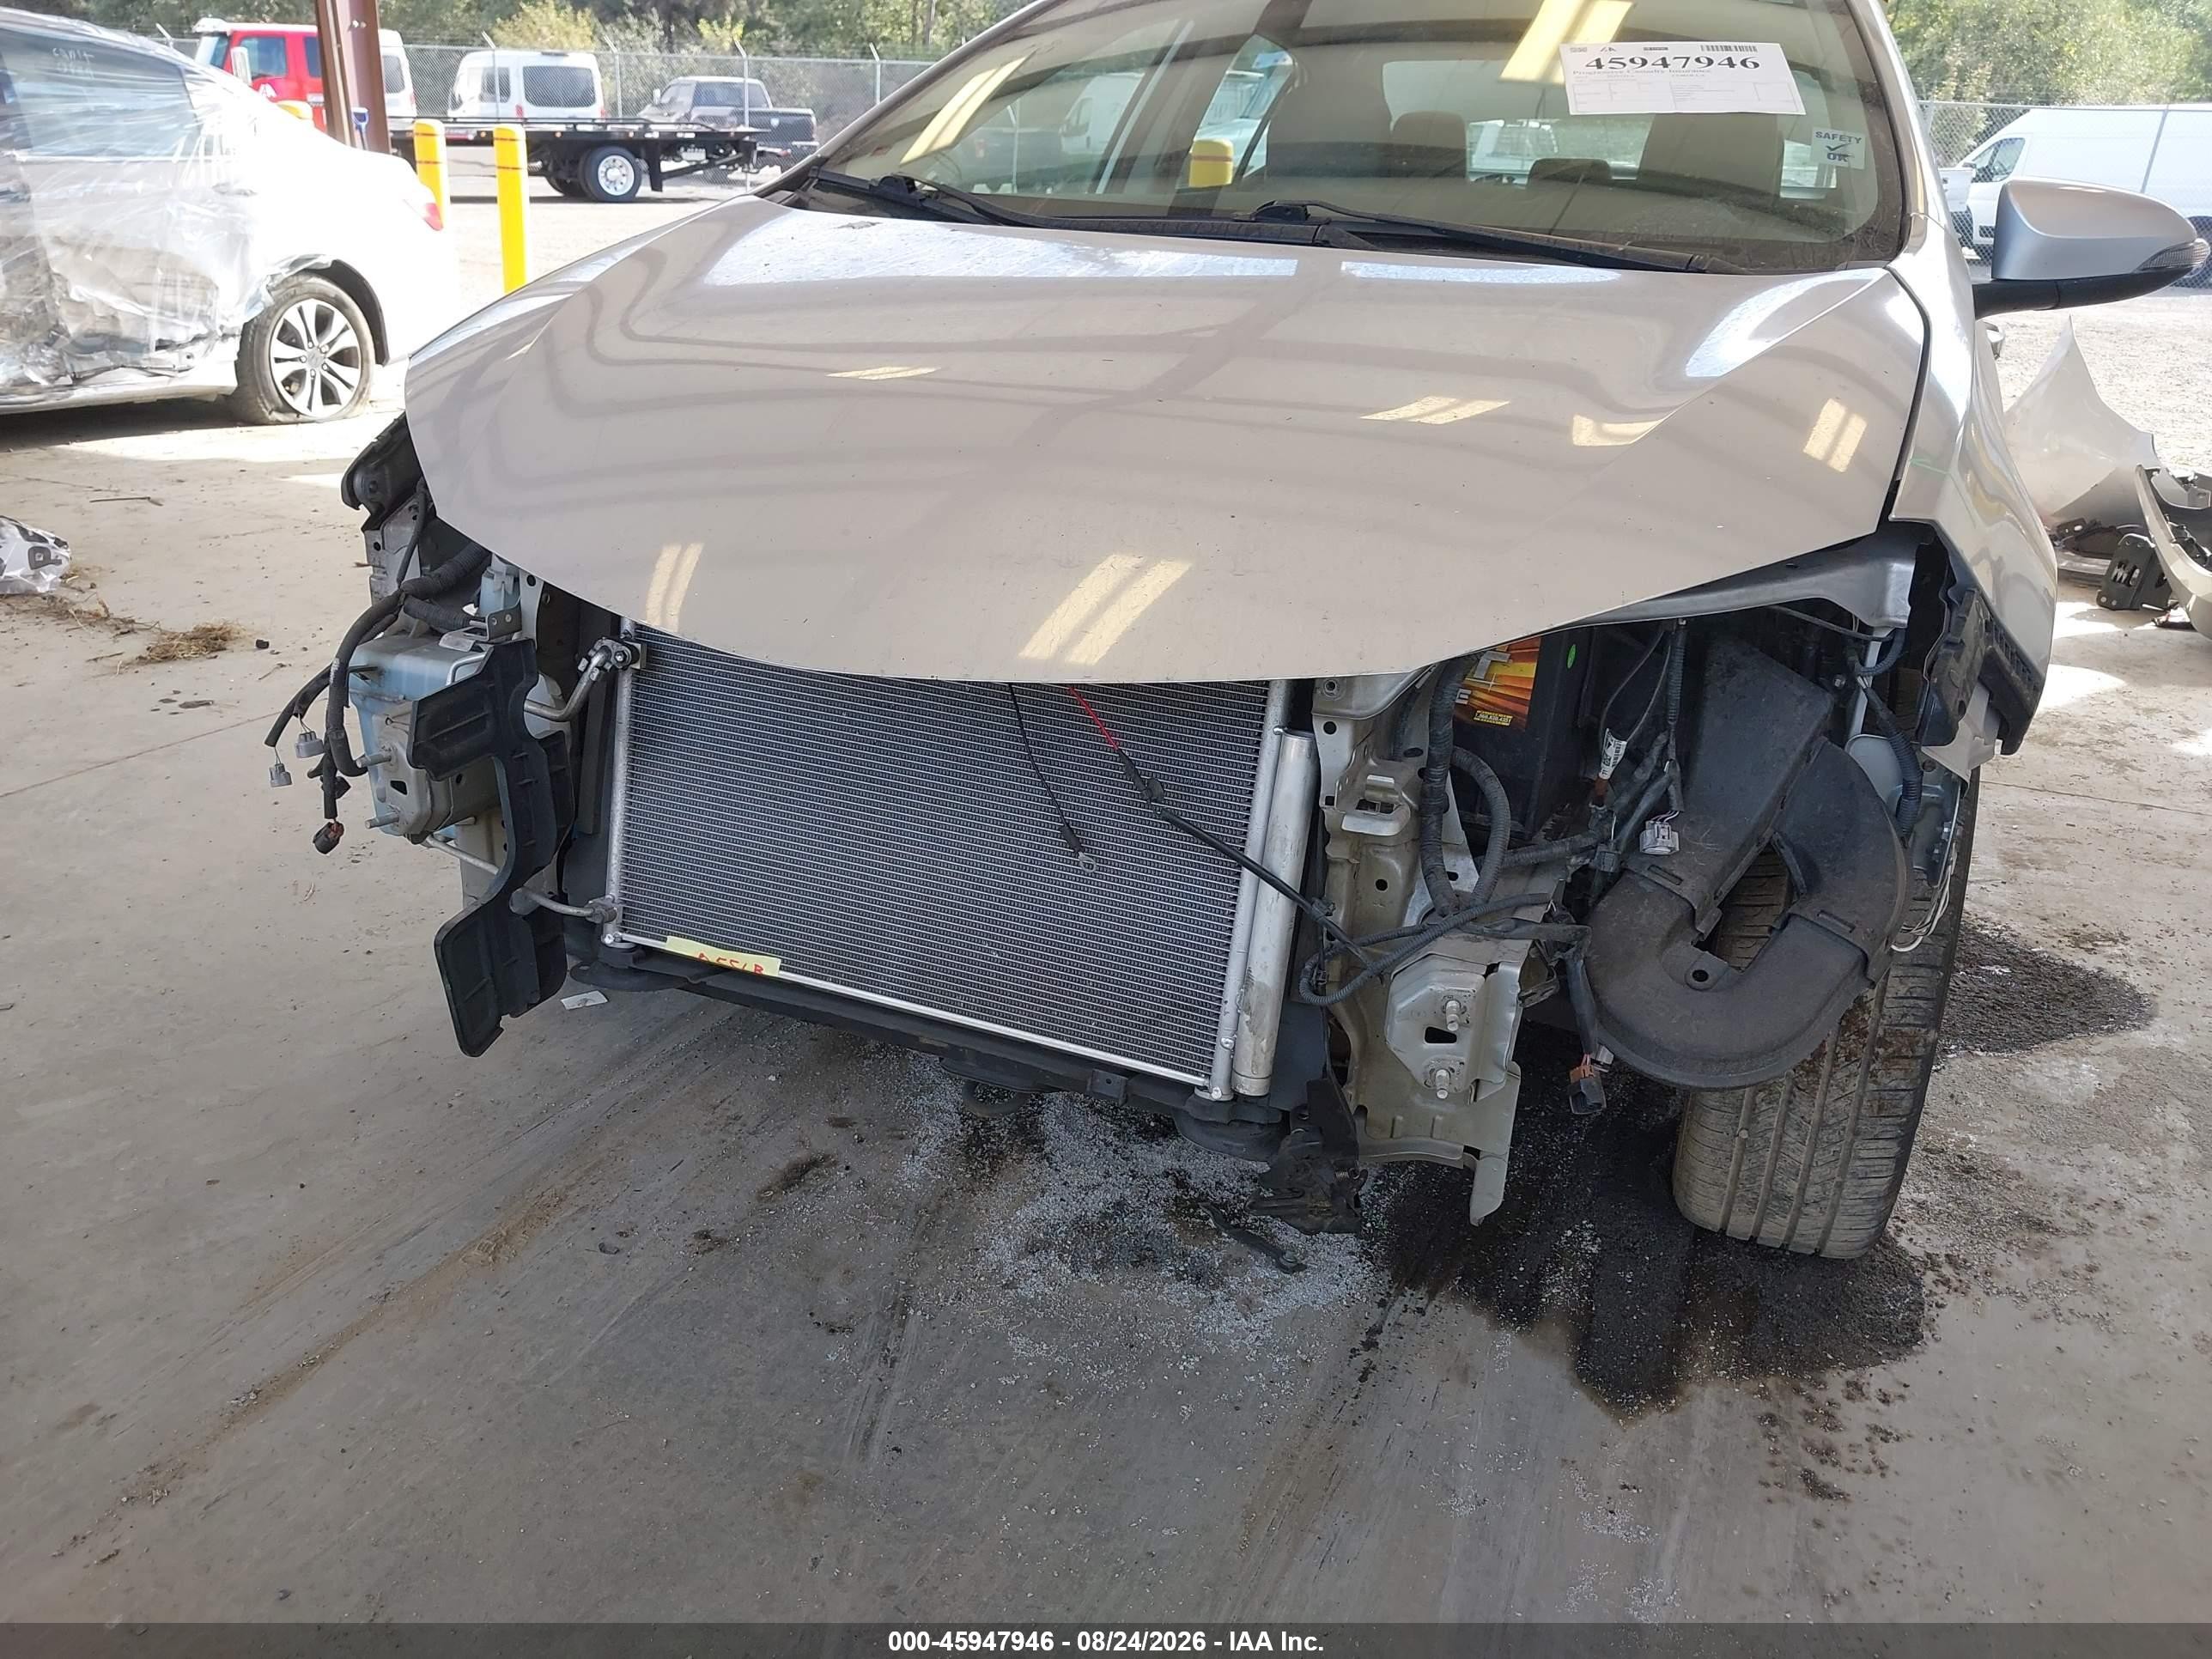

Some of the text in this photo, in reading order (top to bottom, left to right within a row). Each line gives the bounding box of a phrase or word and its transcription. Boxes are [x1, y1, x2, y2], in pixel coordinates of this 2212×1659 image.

[1585, 56, 1759, 70] 45947946
[1815, 131, 1862, 143] SAFETY
[1826, 152, 1850, 162] OK
